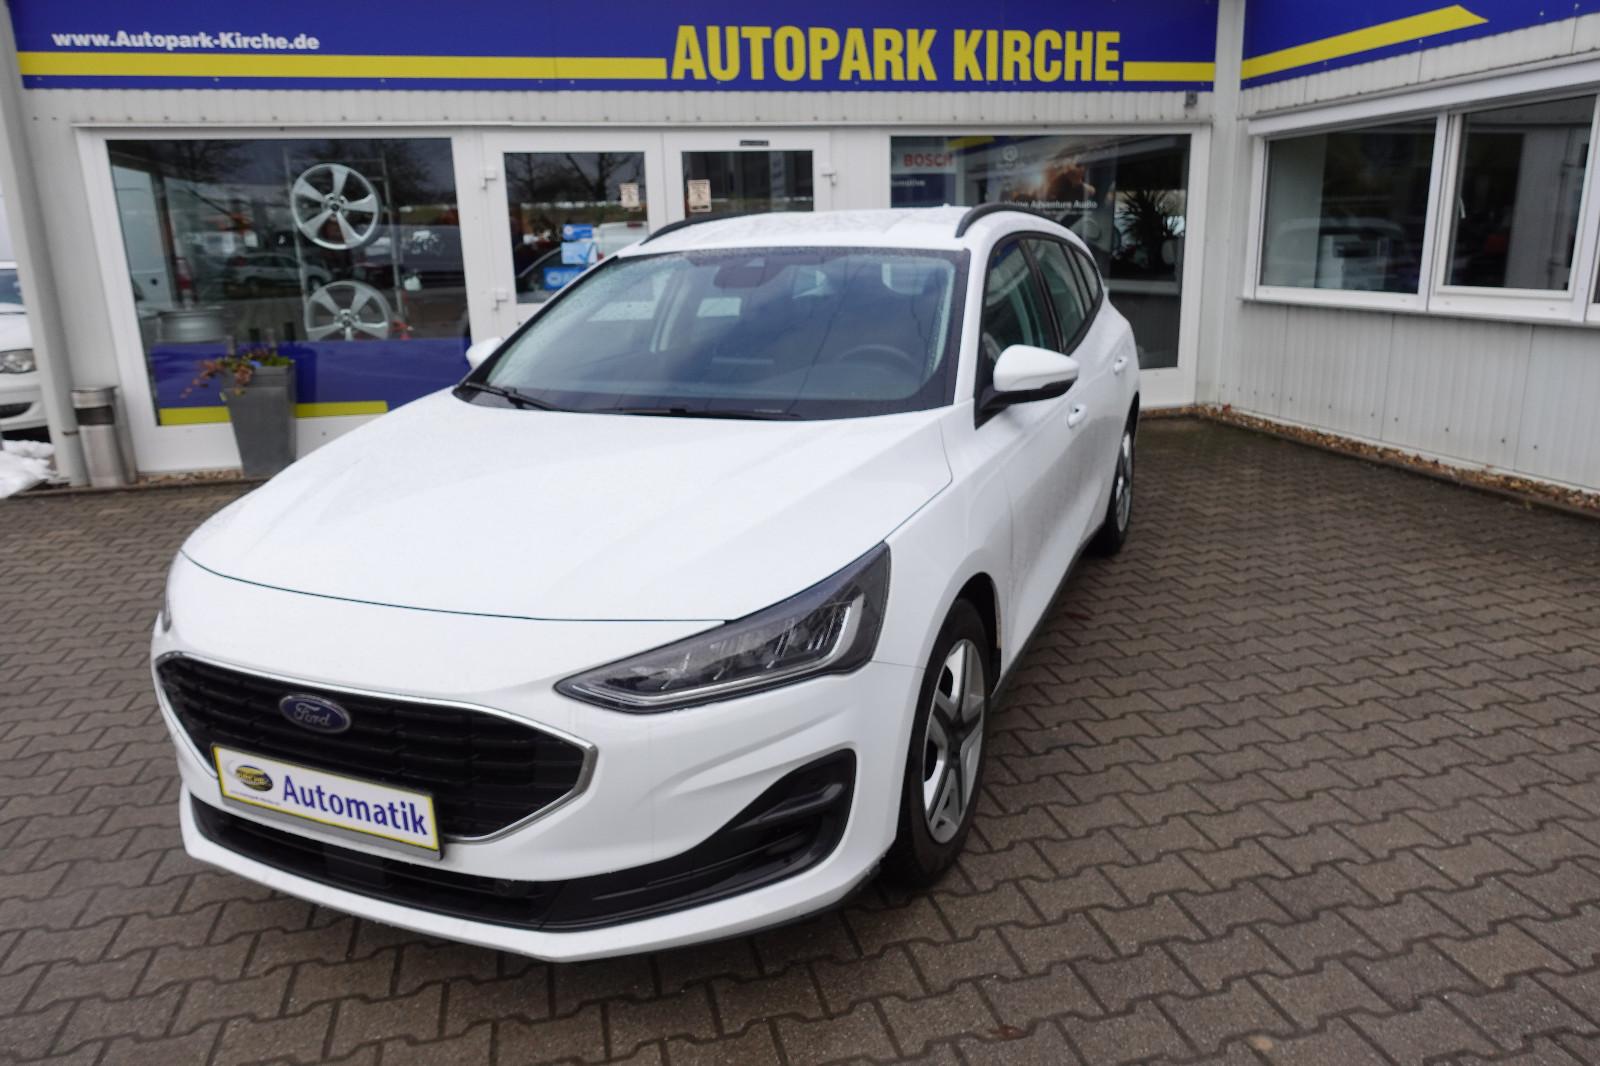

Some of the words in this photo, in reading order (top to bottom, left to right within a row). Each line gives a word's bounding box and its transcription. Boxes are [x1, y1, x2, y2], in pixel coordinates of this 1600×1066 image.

[51, 31, 320, 51] www.Autopark-Kirche.de
[671, 25, 937, 81] AUTOPARK
[953, 29, 1120, 82] KIRCHE
[903, 153, 953, 167] BOSCH
[1072, 199, 1098, 209] Audio
[294, 701, 331, 726] Ford
[282, 774, 428, 836] Automatik
